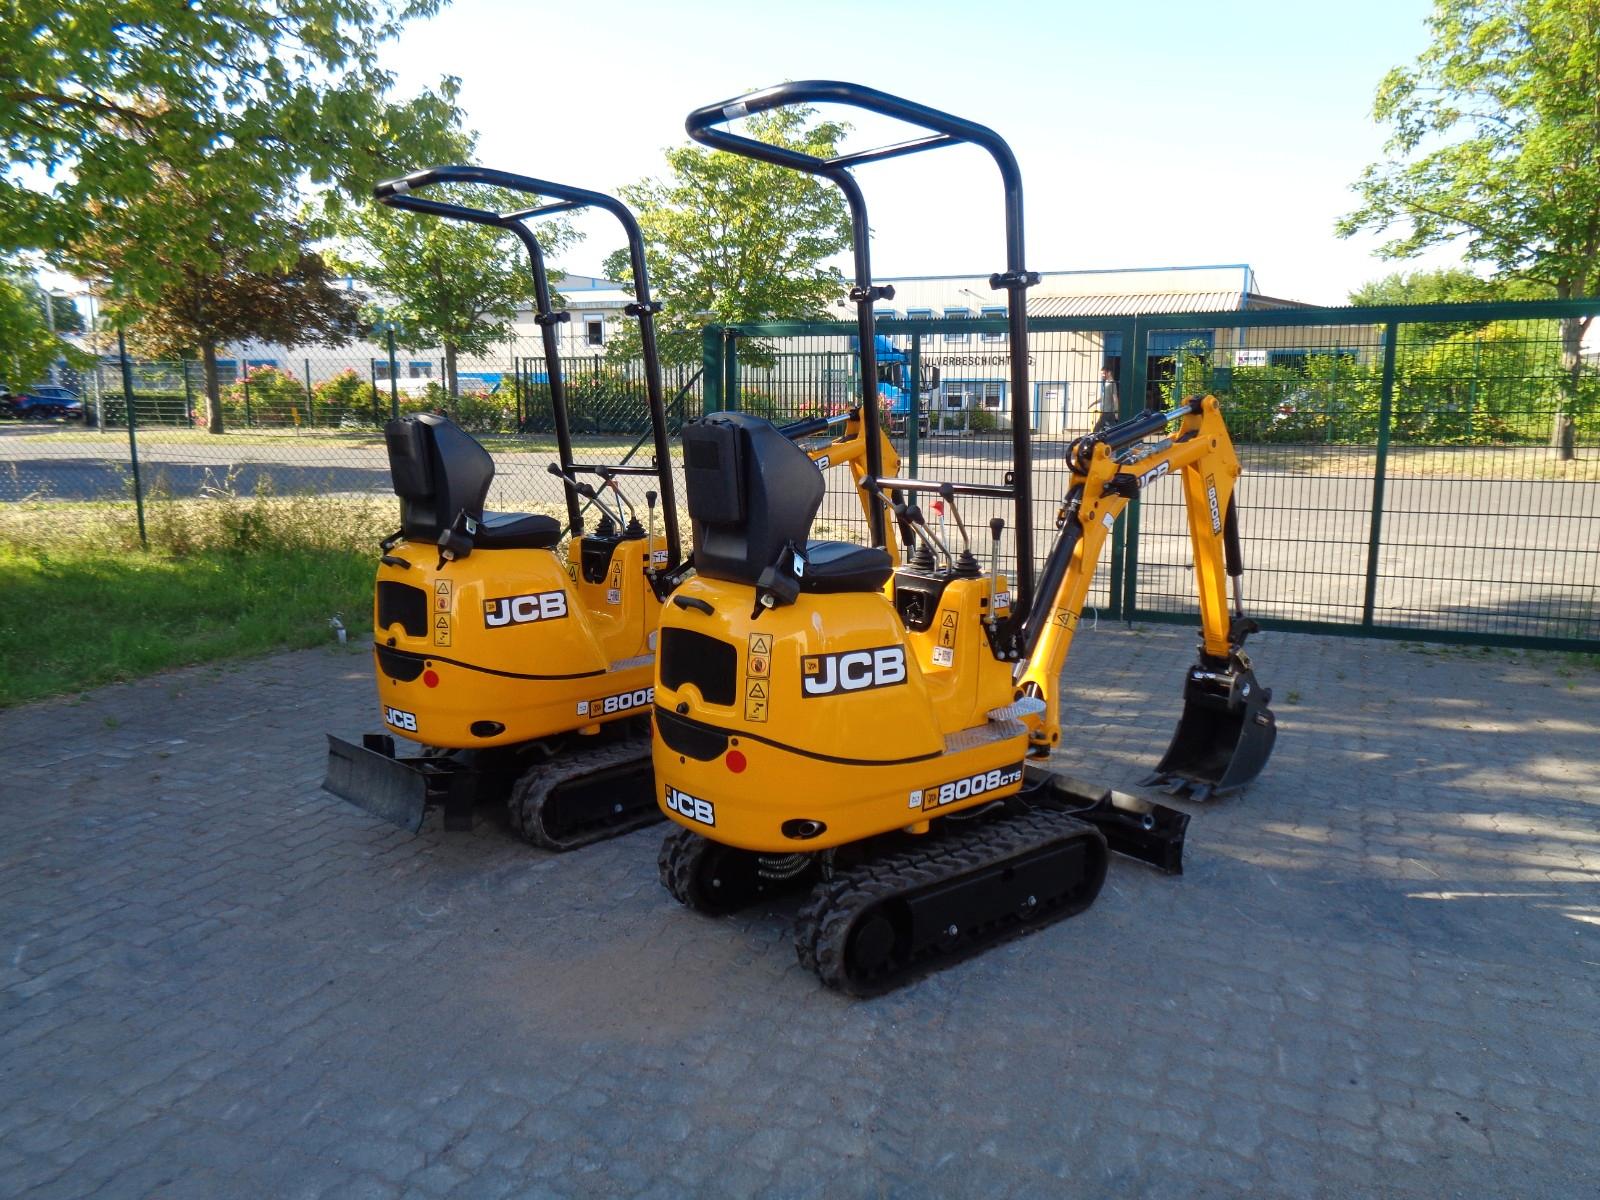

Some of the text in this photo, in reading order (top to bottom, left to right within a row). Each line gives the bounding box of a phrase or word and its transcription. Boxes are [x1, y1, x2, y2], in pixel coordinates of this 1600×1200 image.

[486, 592, 567, 626] JCB
[804, 648, 906, 694] JCB
[384, 707, 417, 731] JCB
[666, 789, 714, 825] JCB
